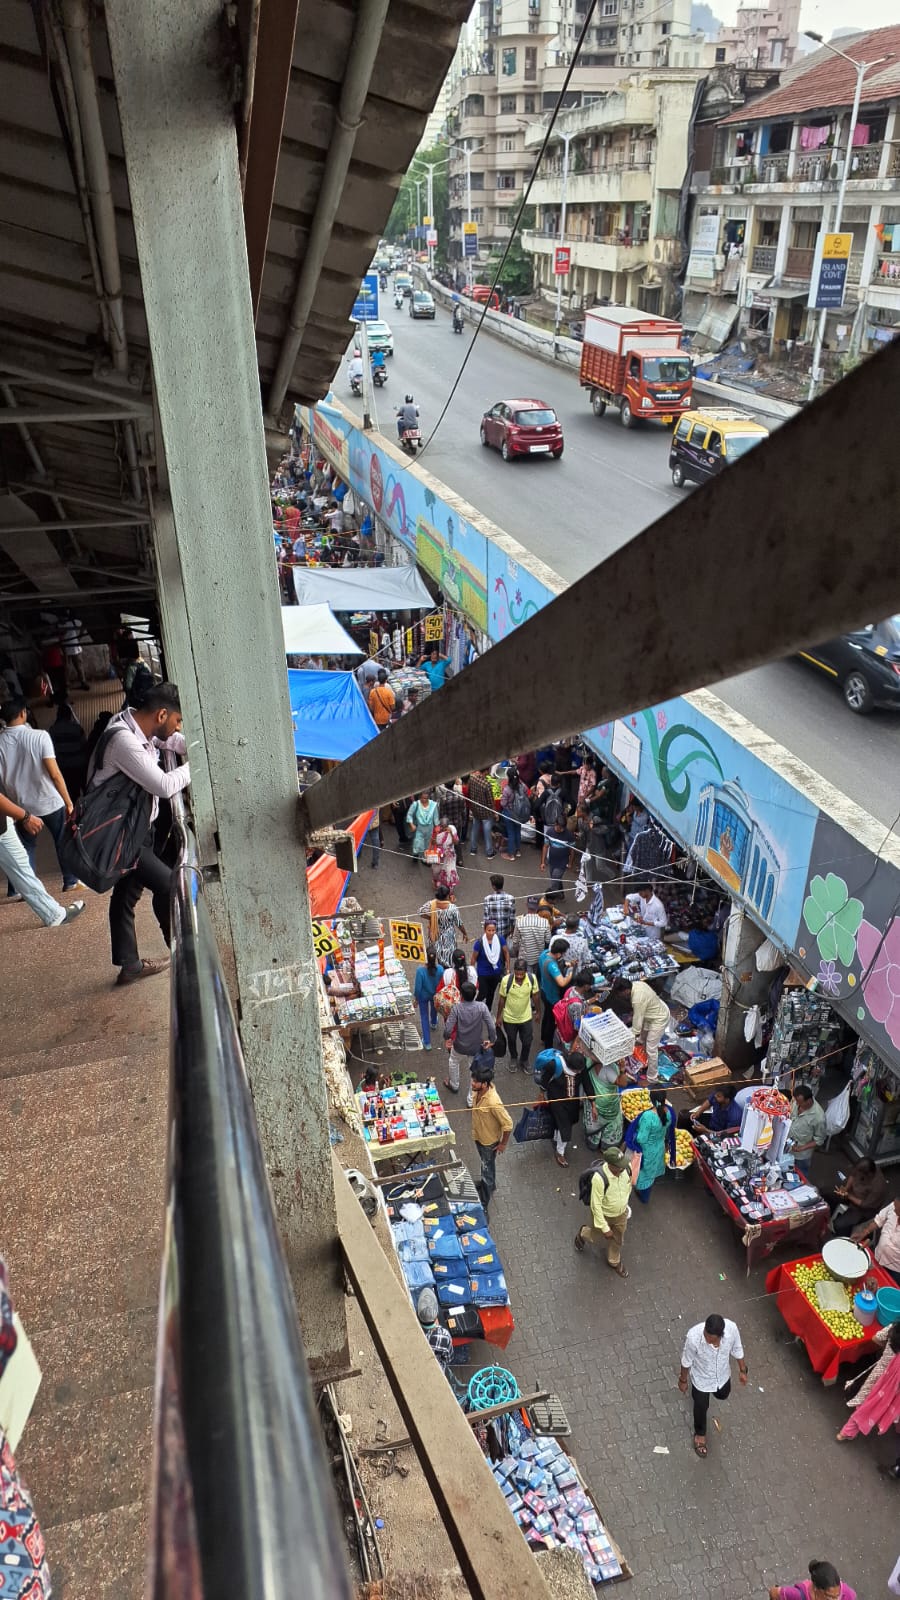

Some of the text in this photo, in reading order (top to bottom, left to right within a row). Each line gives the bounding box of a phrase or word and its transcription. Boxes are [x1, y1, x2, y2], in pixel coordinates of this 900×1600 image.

[823, 271, 842, 279] COVE
[429, 618, 441, 627] 50
[429, 629, 441, 639] 50
[398, 925, 418, 942] 50
[401, 945, 421, 960] 50
